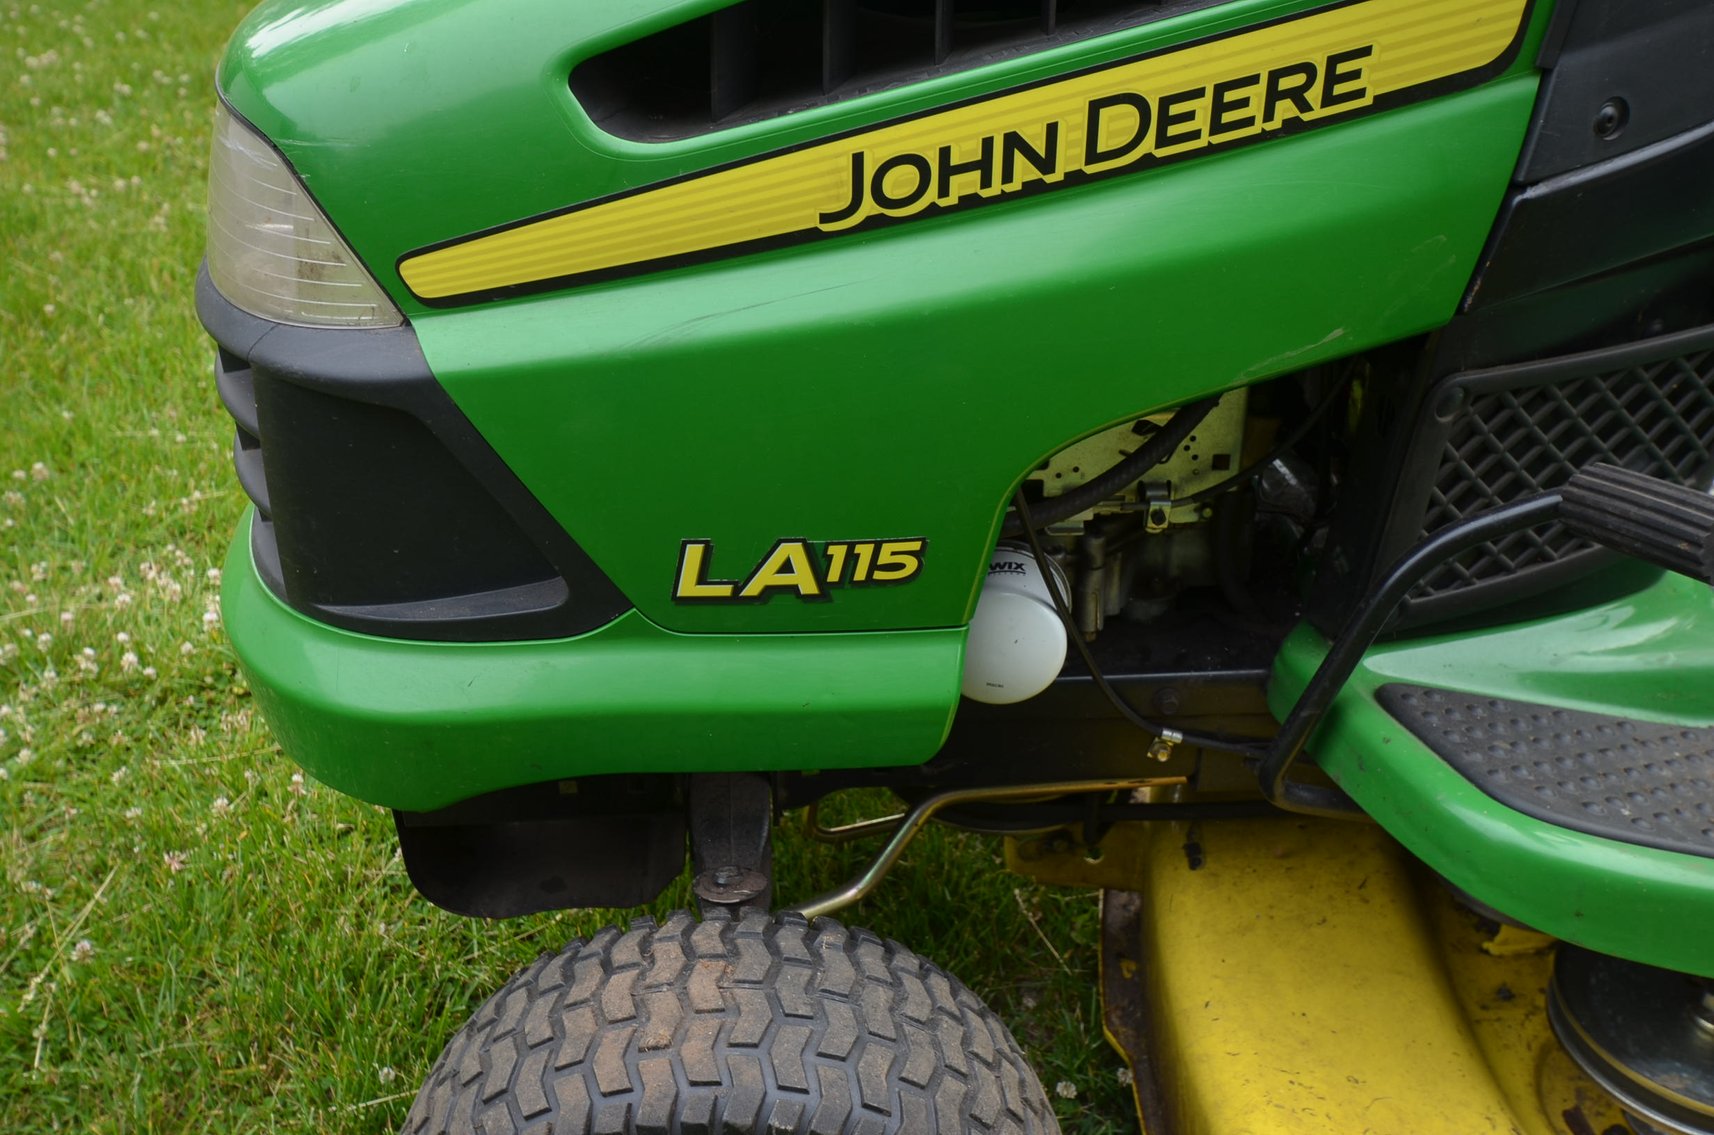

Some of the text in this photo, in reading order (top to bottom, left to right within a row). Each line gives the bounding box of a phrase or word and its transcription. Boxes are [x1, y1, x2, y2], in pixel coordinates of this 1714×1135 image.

[818, 45, 1374, 226] JOHN DEERE
[988, 561, 1026, 572] WIX
